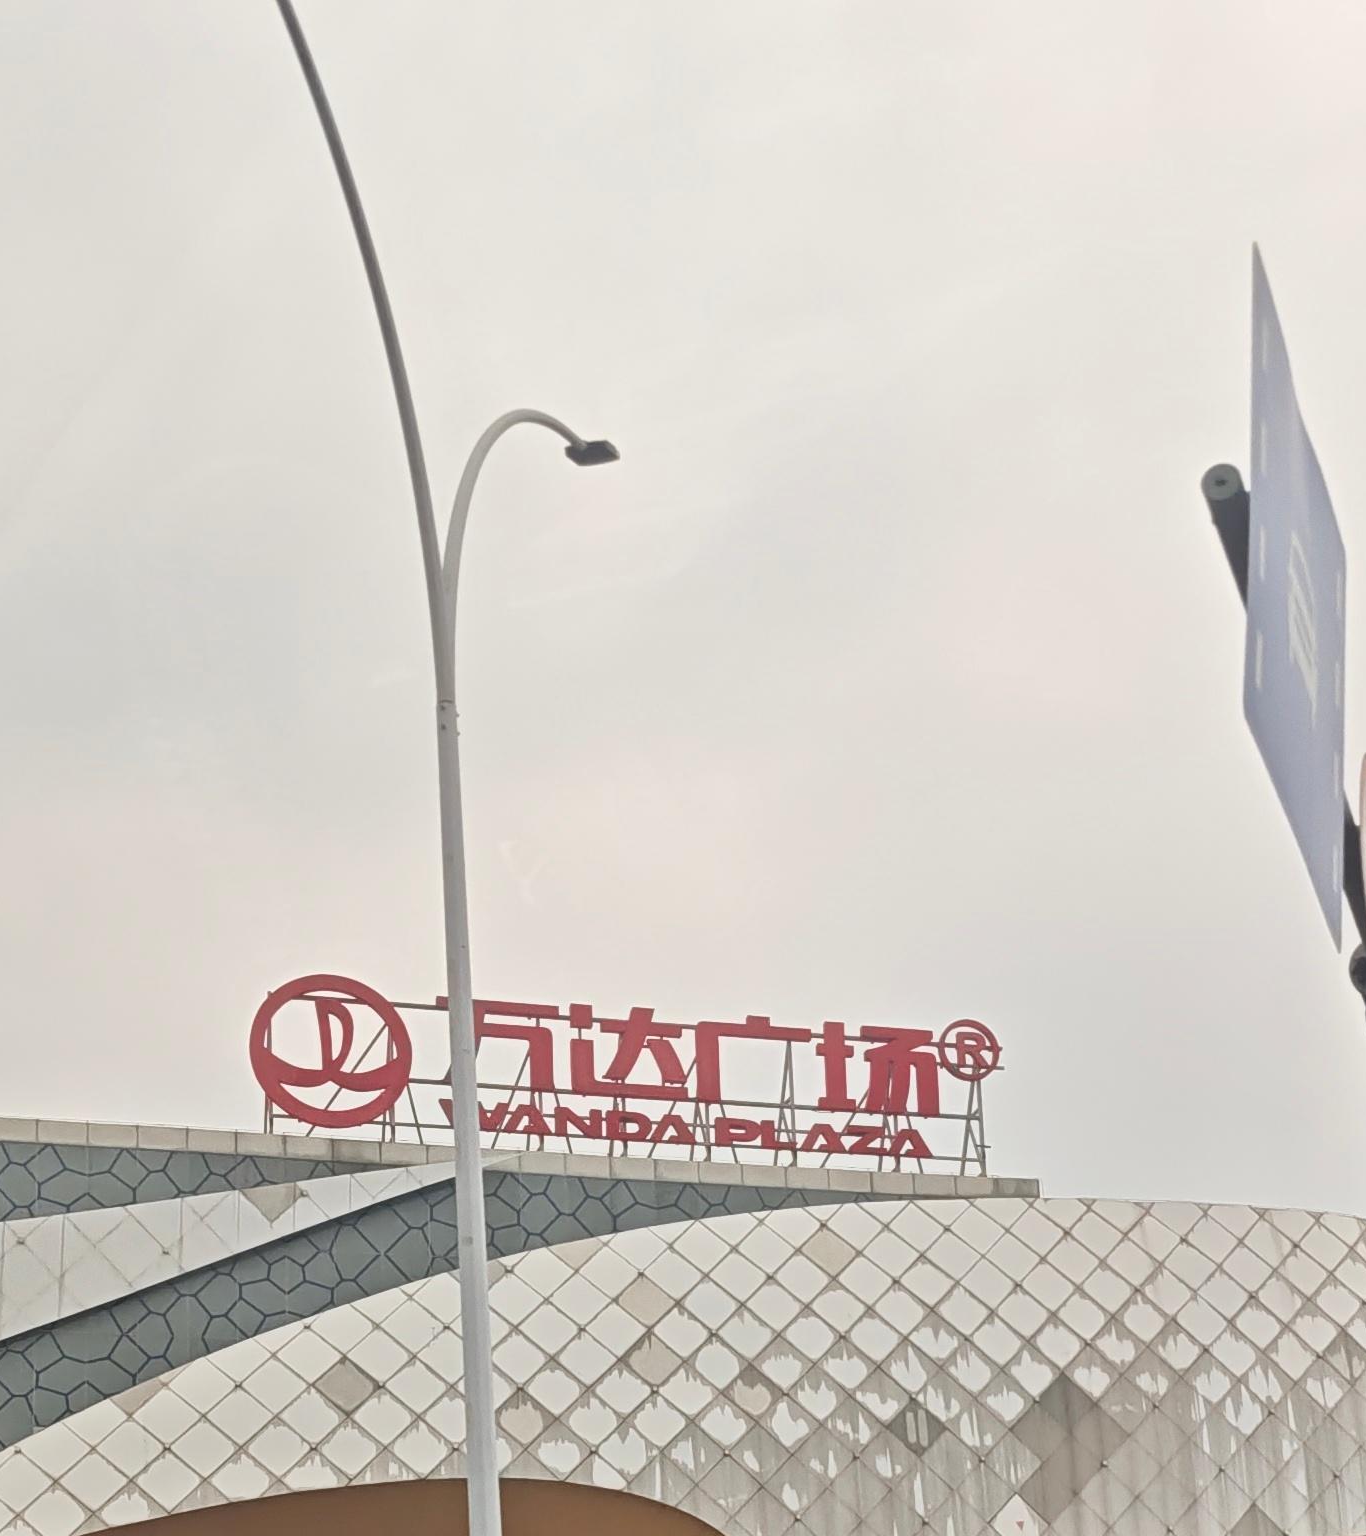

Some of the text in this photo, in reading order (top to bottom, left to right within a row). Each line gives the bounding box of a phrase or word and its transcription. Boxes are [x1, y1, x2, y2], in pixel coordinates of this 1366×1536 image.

[436, 995, 941, 1117] 万达广场
[438, 1097, 933, 1159] WANDA PLAZA
